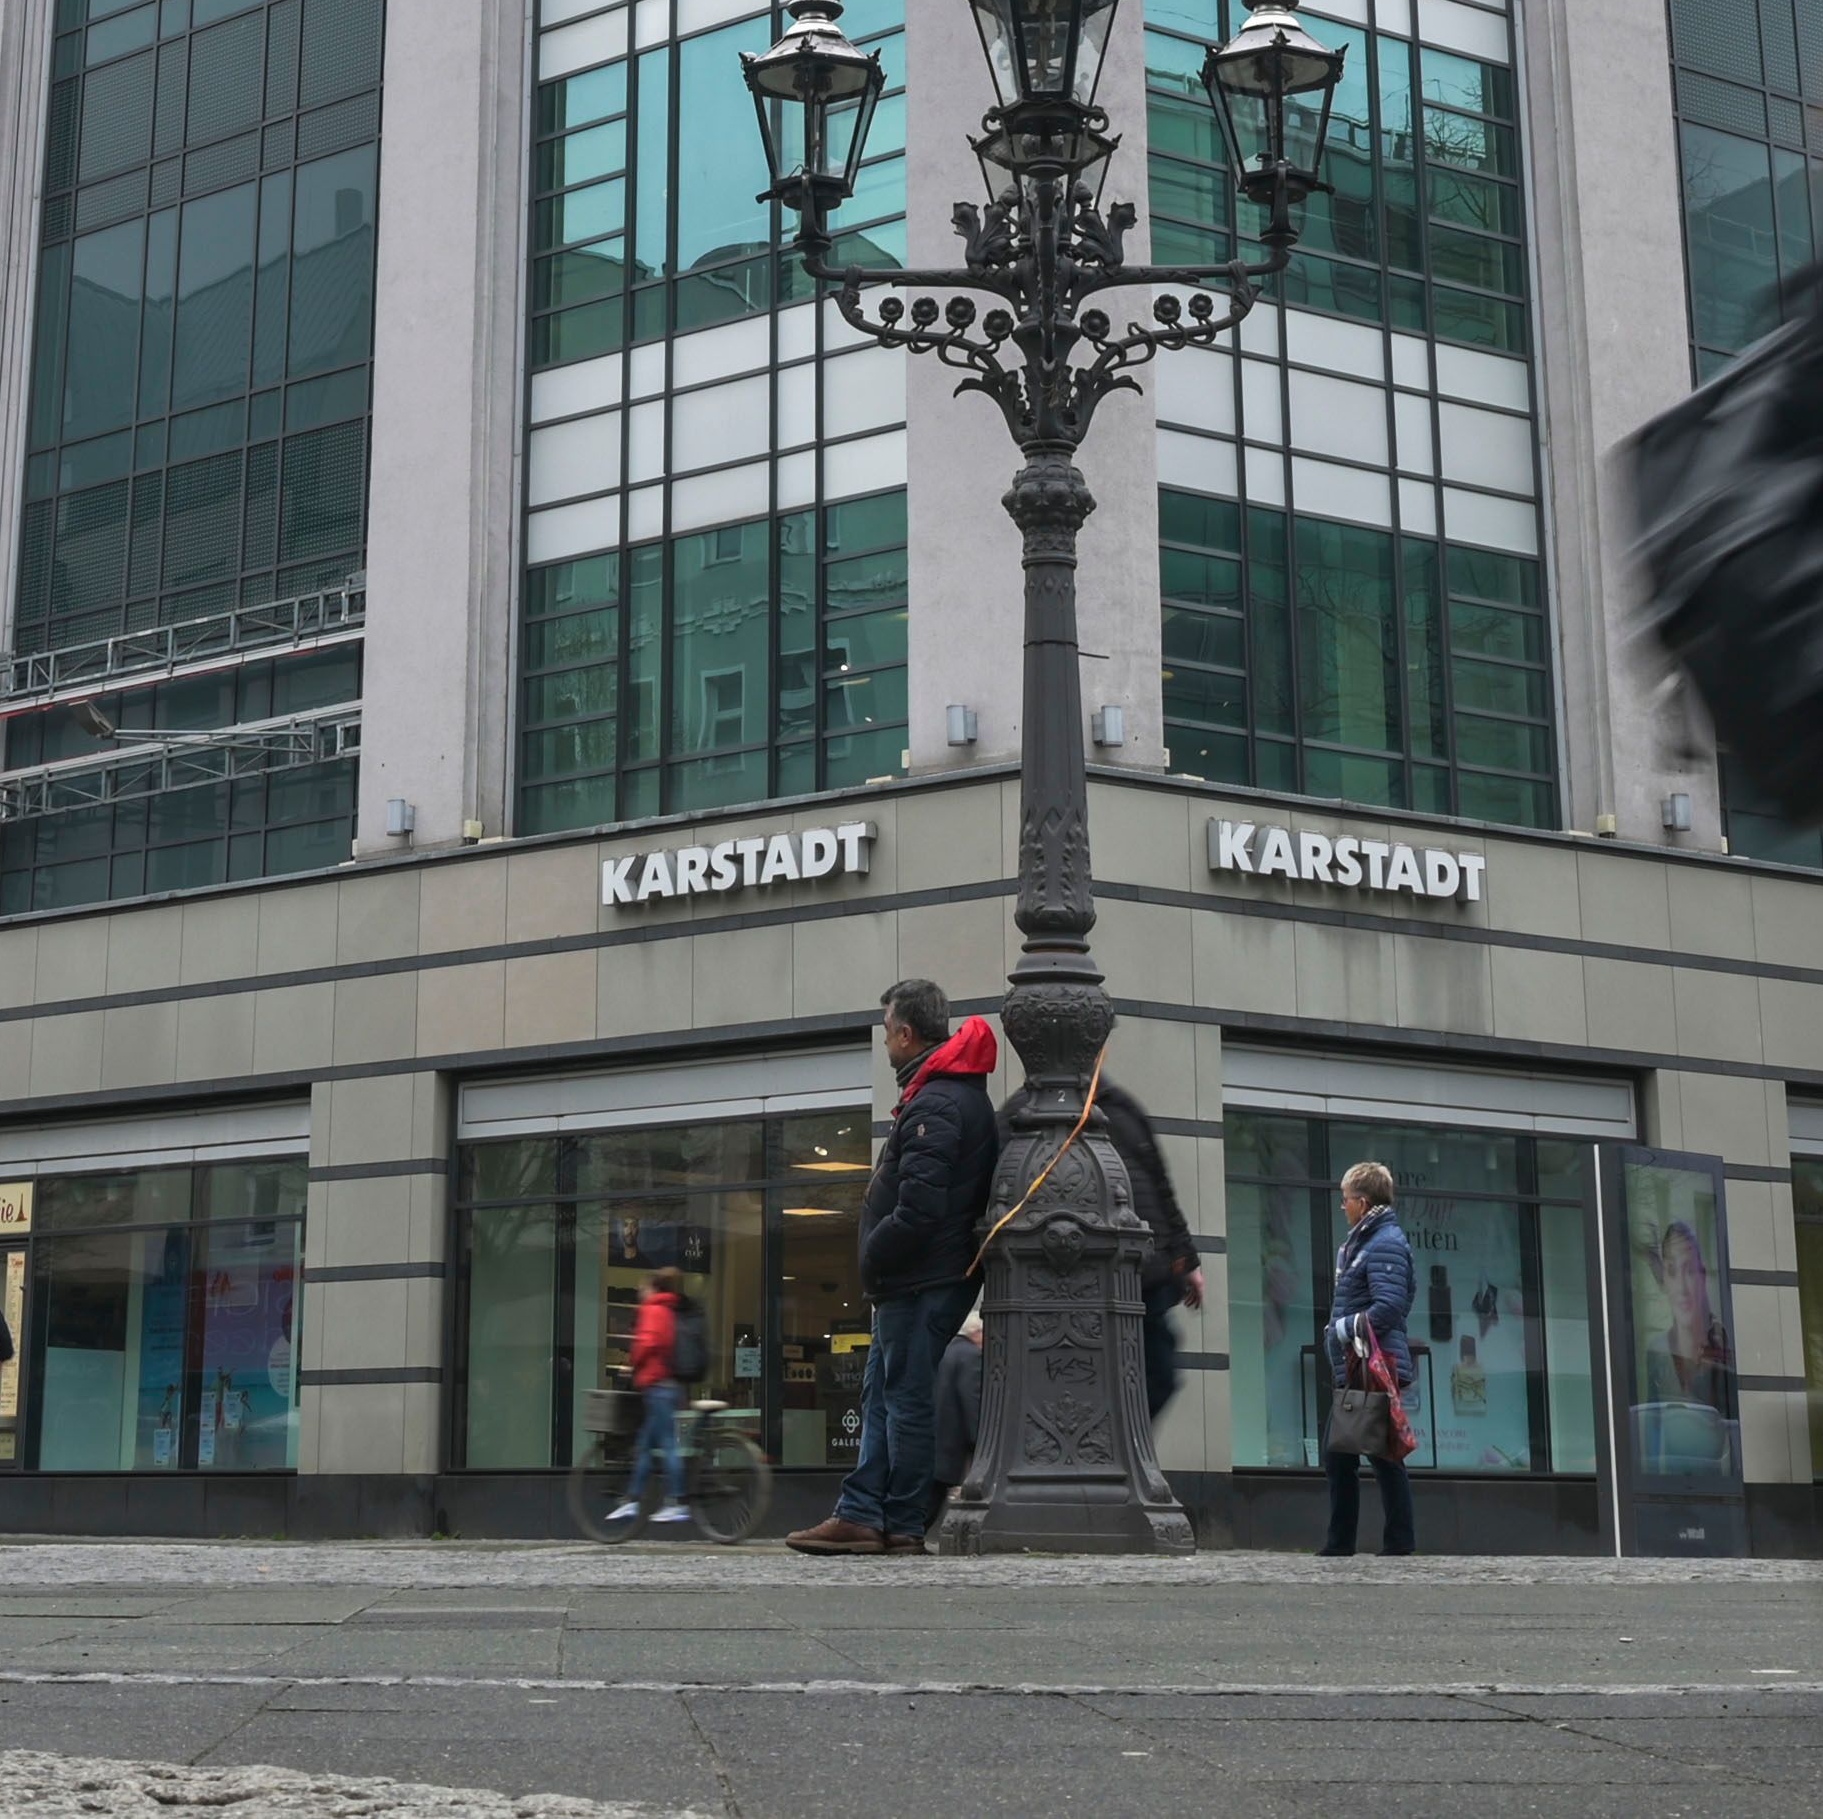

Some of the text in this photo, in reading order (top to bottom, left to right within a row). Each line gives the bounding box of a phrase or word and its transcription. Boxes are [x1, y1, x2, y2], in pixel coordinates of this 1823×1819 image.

[601, 821, 876, 907] KARSTADT
[1208, 818, 1486, 902] KARSTADT
[1057, 1090, 1066, 1102] 2
